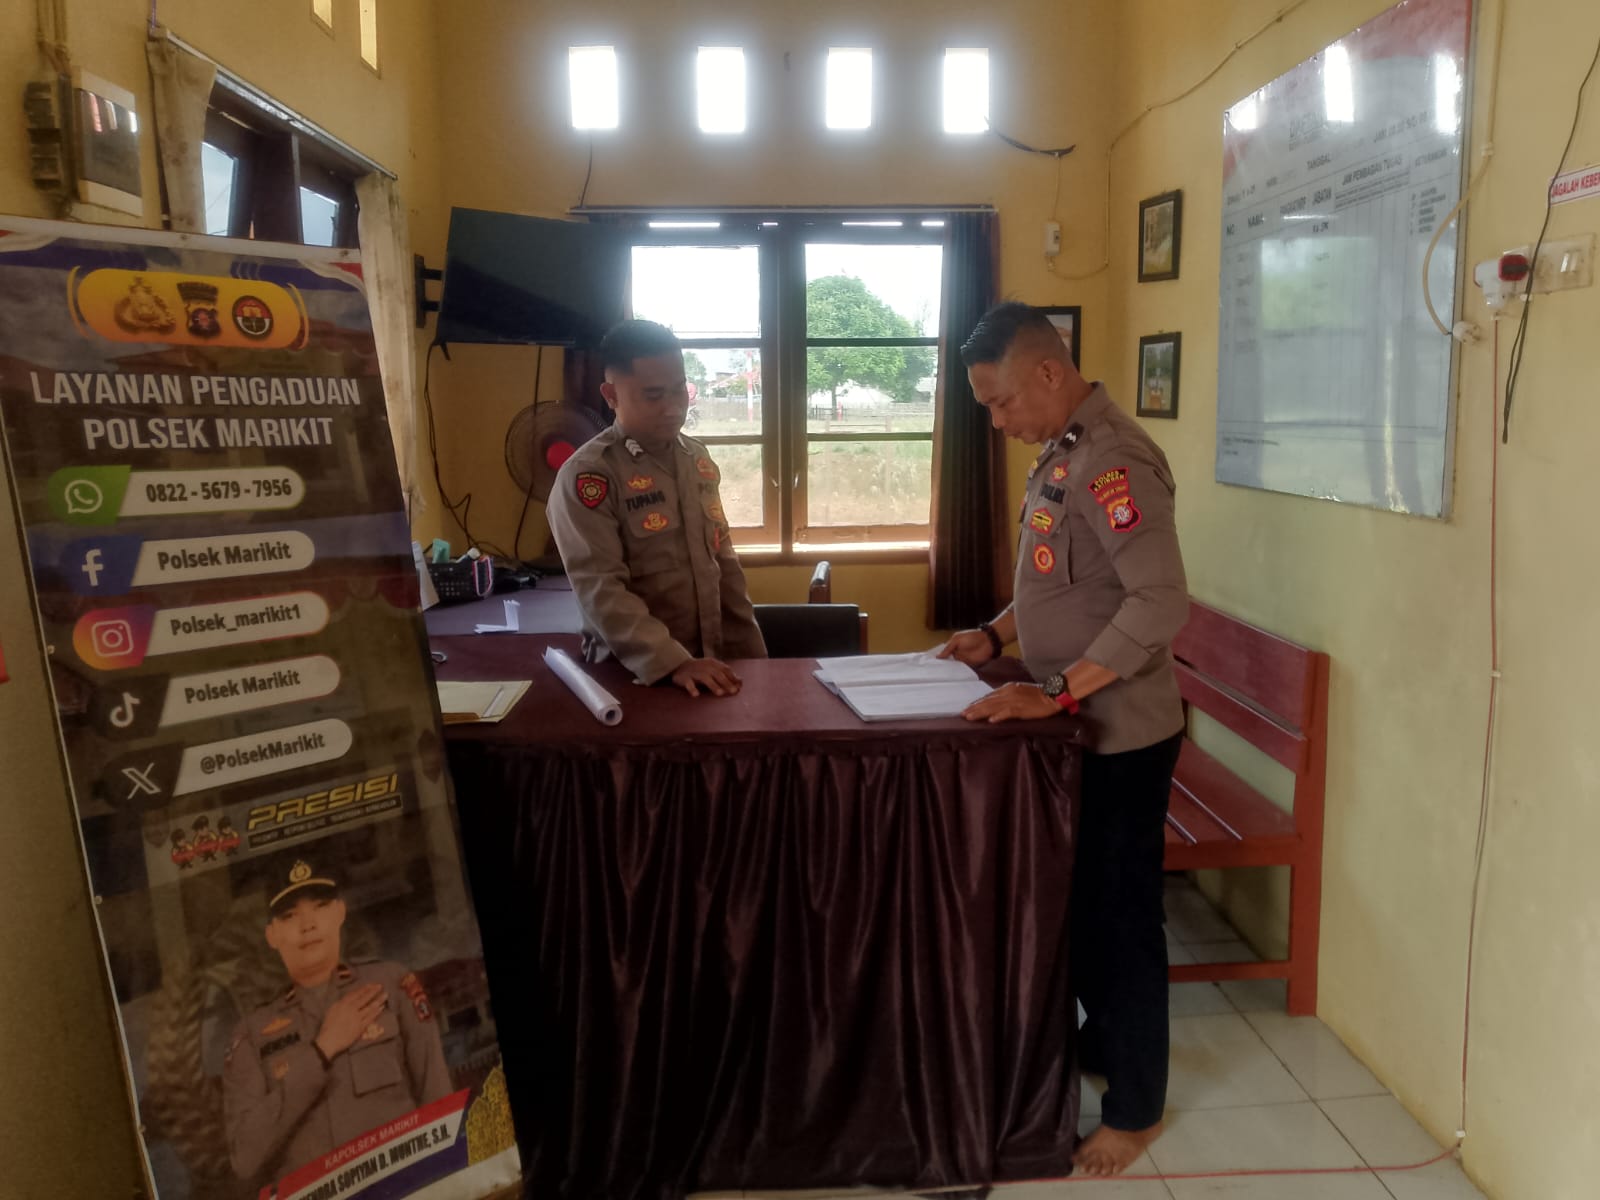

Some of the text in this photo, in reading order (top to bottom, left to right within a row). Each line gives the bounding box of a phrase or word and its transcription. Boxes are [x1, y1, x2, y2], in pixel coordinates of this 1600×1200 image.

[30, 371, 361, 406] LAYANAN PENGADUAN
[84, 416, 333, 450] POLSEK MARIKIT
[157, 542, 292, 571] Polsek Marikit
[170, 604, 301, 636] Polsek_marikit1
[184, 670, 300, 704] Polsek Marikit
[200, 733, 326, 774] @PolsekMarikit
[247, 773, 399, 830] PRESISI
[324, 1114, 420, 1169] KAPOLSEK MARIKIT
[337, 1157, 379, 1192] SOPIYAN
[378, 1152, 389, 1170] D.
